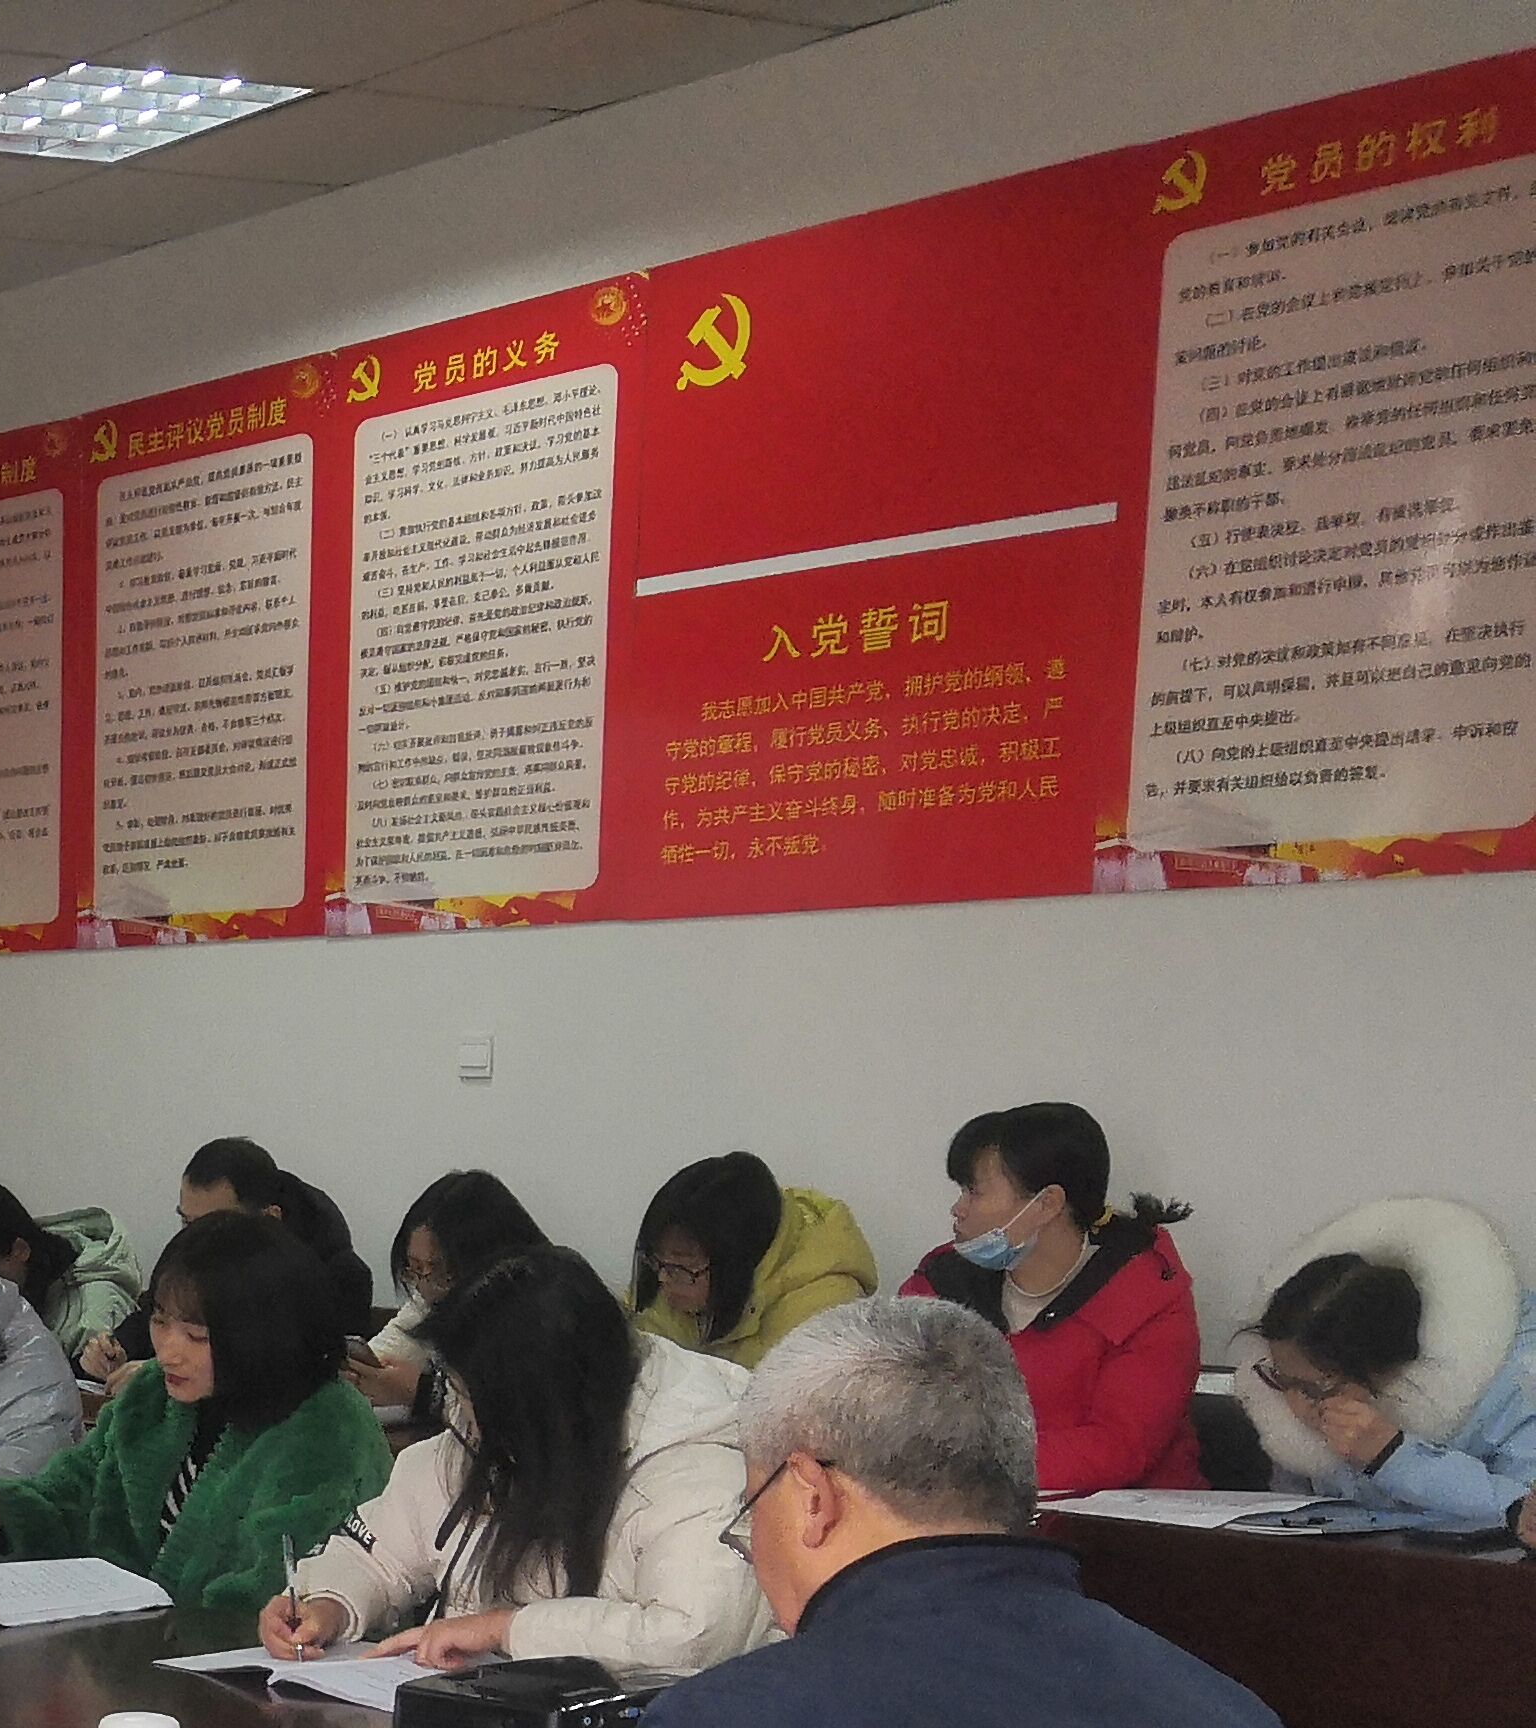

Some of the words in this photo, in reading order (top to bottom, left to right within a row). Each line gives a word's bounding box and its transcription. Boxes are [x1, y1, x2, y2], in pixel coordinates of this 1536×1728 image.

[1261, 106, 1498, 196] 党员的权利
[412, 330, 560, 393] 党员的义务
[128, 396, 287, 458] 民主评议党员制度
[762, 599, 950, 663] 入党誓词
